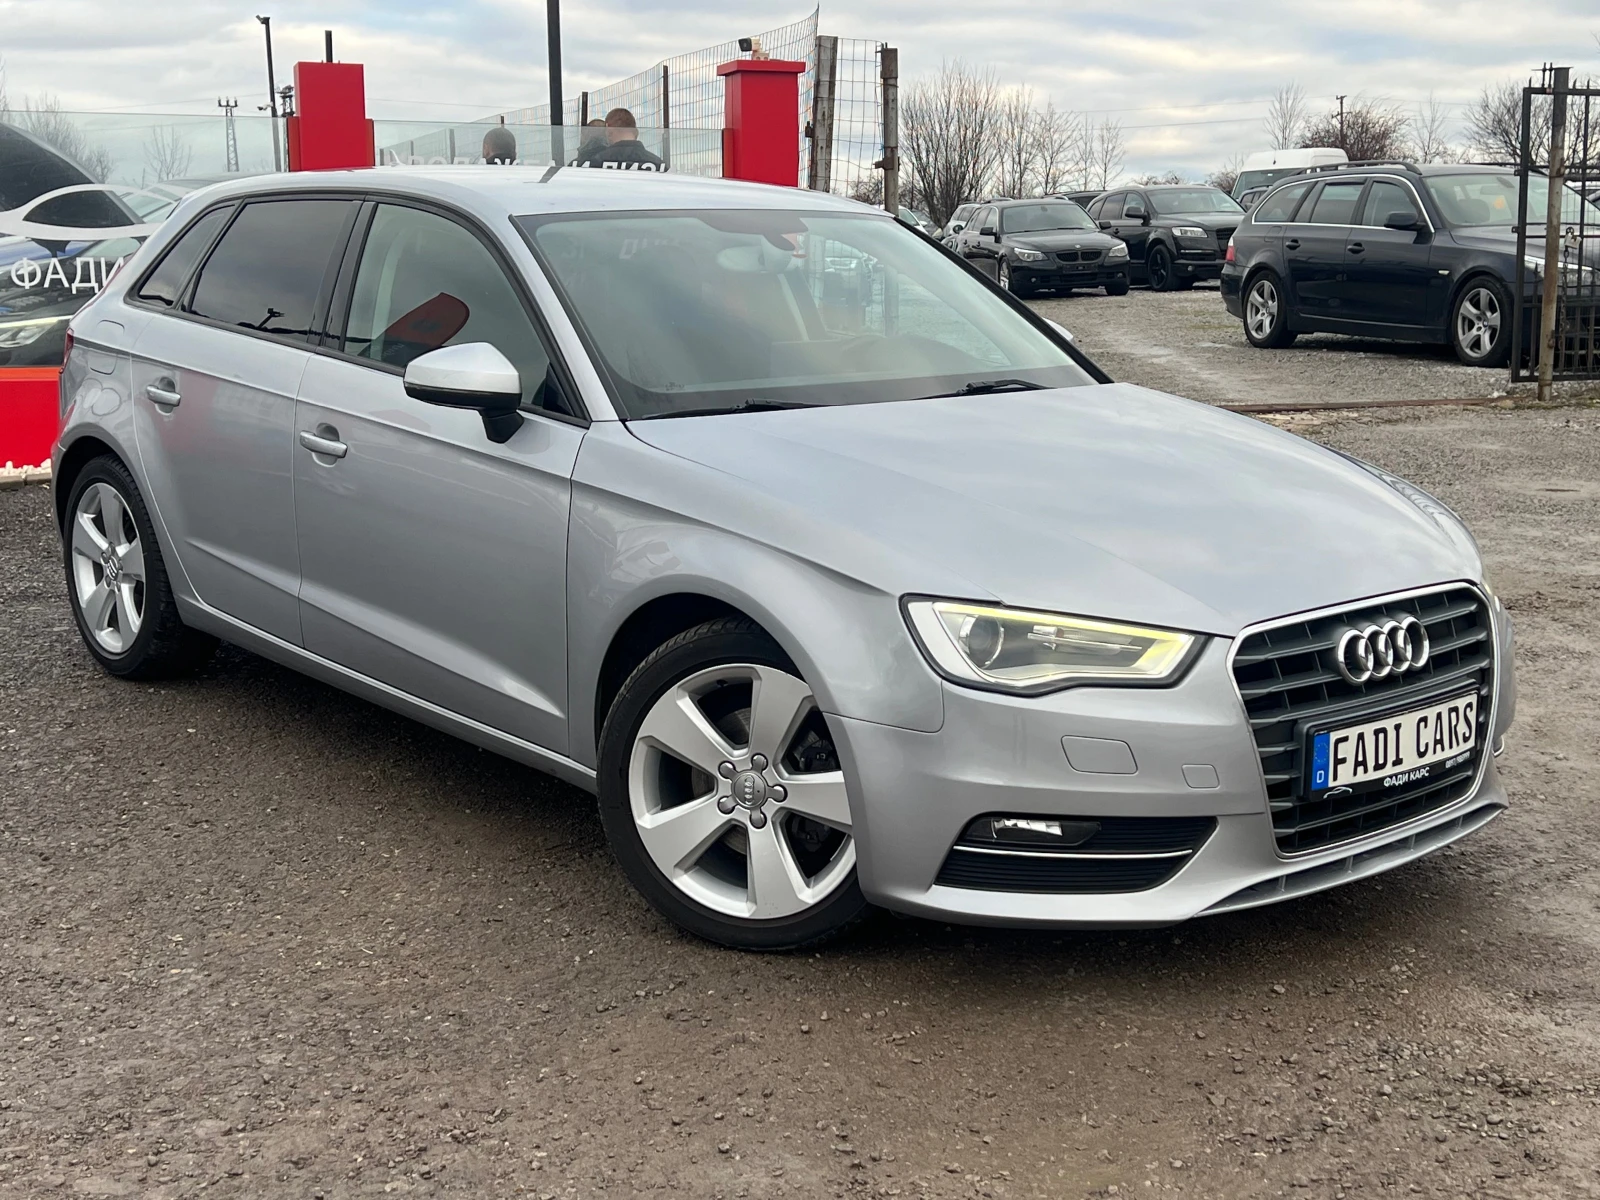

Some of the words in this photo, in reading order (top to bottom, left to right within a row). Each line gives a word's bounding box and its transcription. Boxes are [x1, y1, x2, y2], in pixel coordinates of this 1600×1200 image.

[1332, 722, 1403, 781] FADI
[1416, 701, 1474, 758] CARS
[1316, 770, 1325, 783] D
[1383, 773, 1409, 787] ФАДИ
[1409, 767, 1430, 781] КАРС
